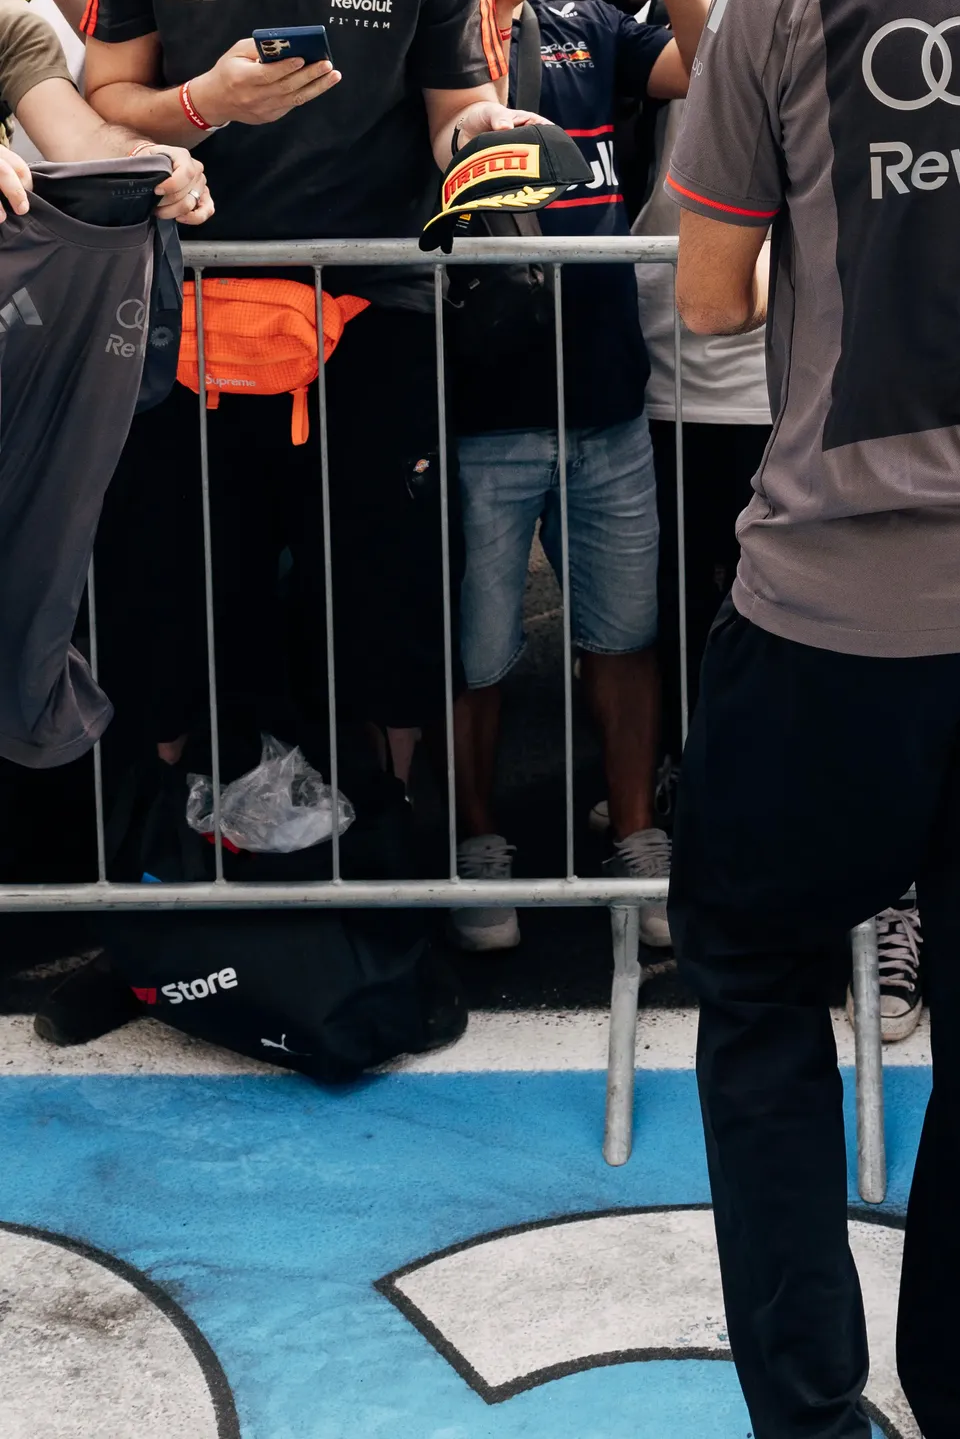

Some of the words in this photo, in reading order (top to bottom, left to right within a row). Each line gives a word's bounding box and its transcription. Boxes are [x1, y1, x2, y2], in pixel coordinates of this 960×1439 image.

[354, 19, 391, 29] TEAM
[443, 150, 530, 205] PIRELLI
[205, 373, 256, 388] Supreme
[161, 966, 239, 1005] Store
